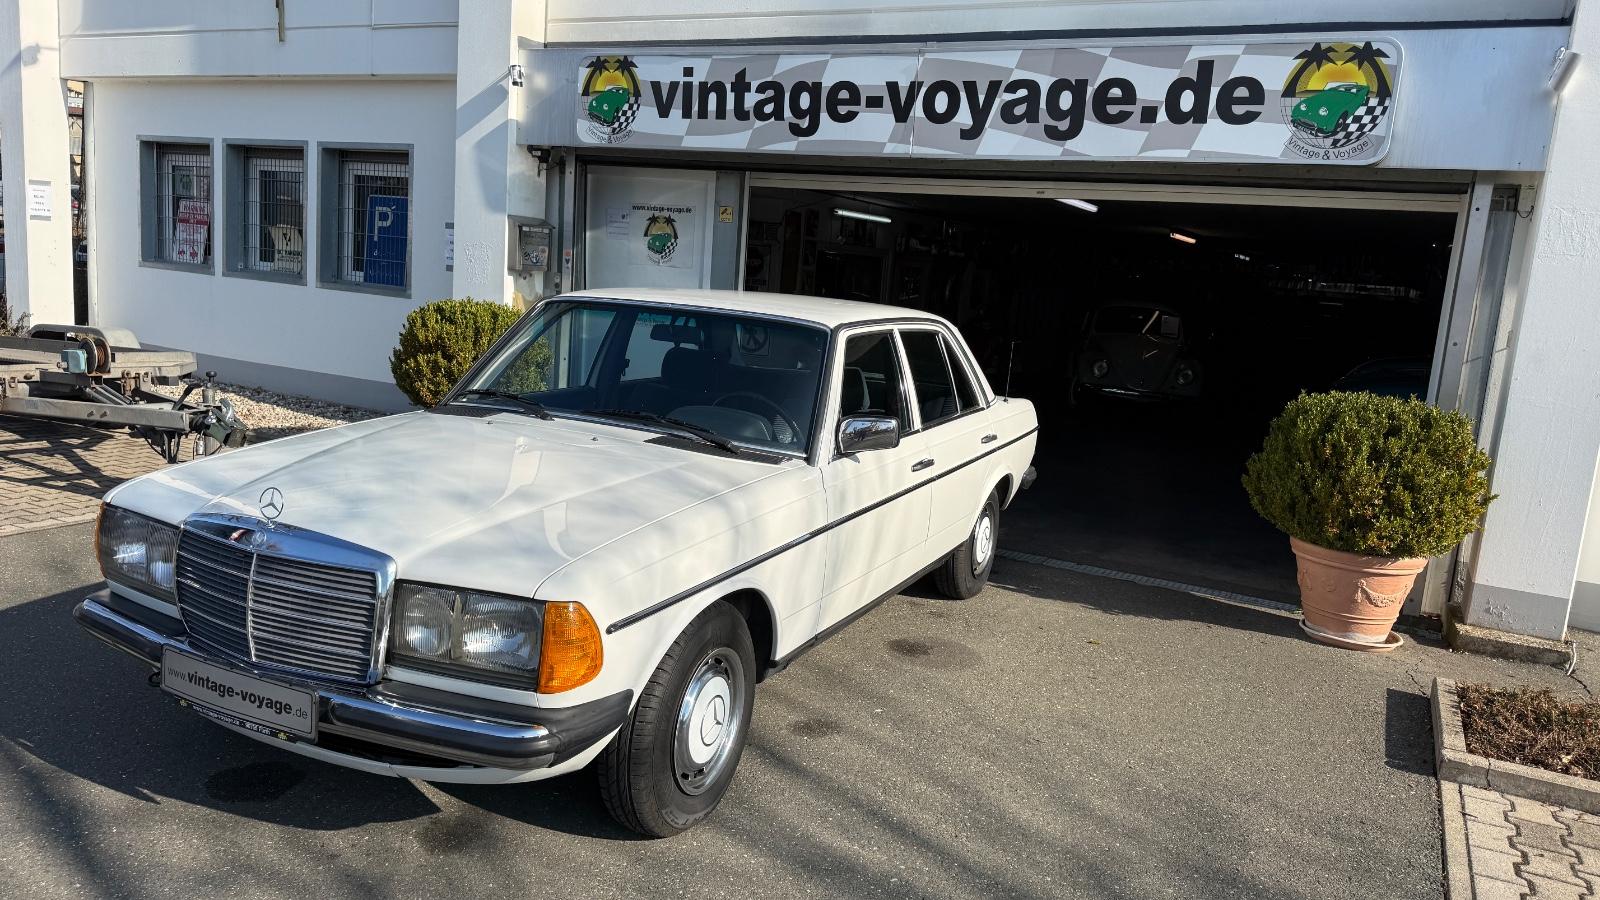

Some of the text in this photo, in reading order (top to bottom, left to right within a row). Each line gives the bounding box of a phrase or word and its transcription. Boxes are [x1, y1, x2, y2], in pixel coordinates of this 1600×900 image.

[650, 60, 1265, 141] vintage-voyage.de
[1288, 137, 1369, 160] Vintage & Voyage
[167, 666, 308, 719] www.vintage-voyage.de
